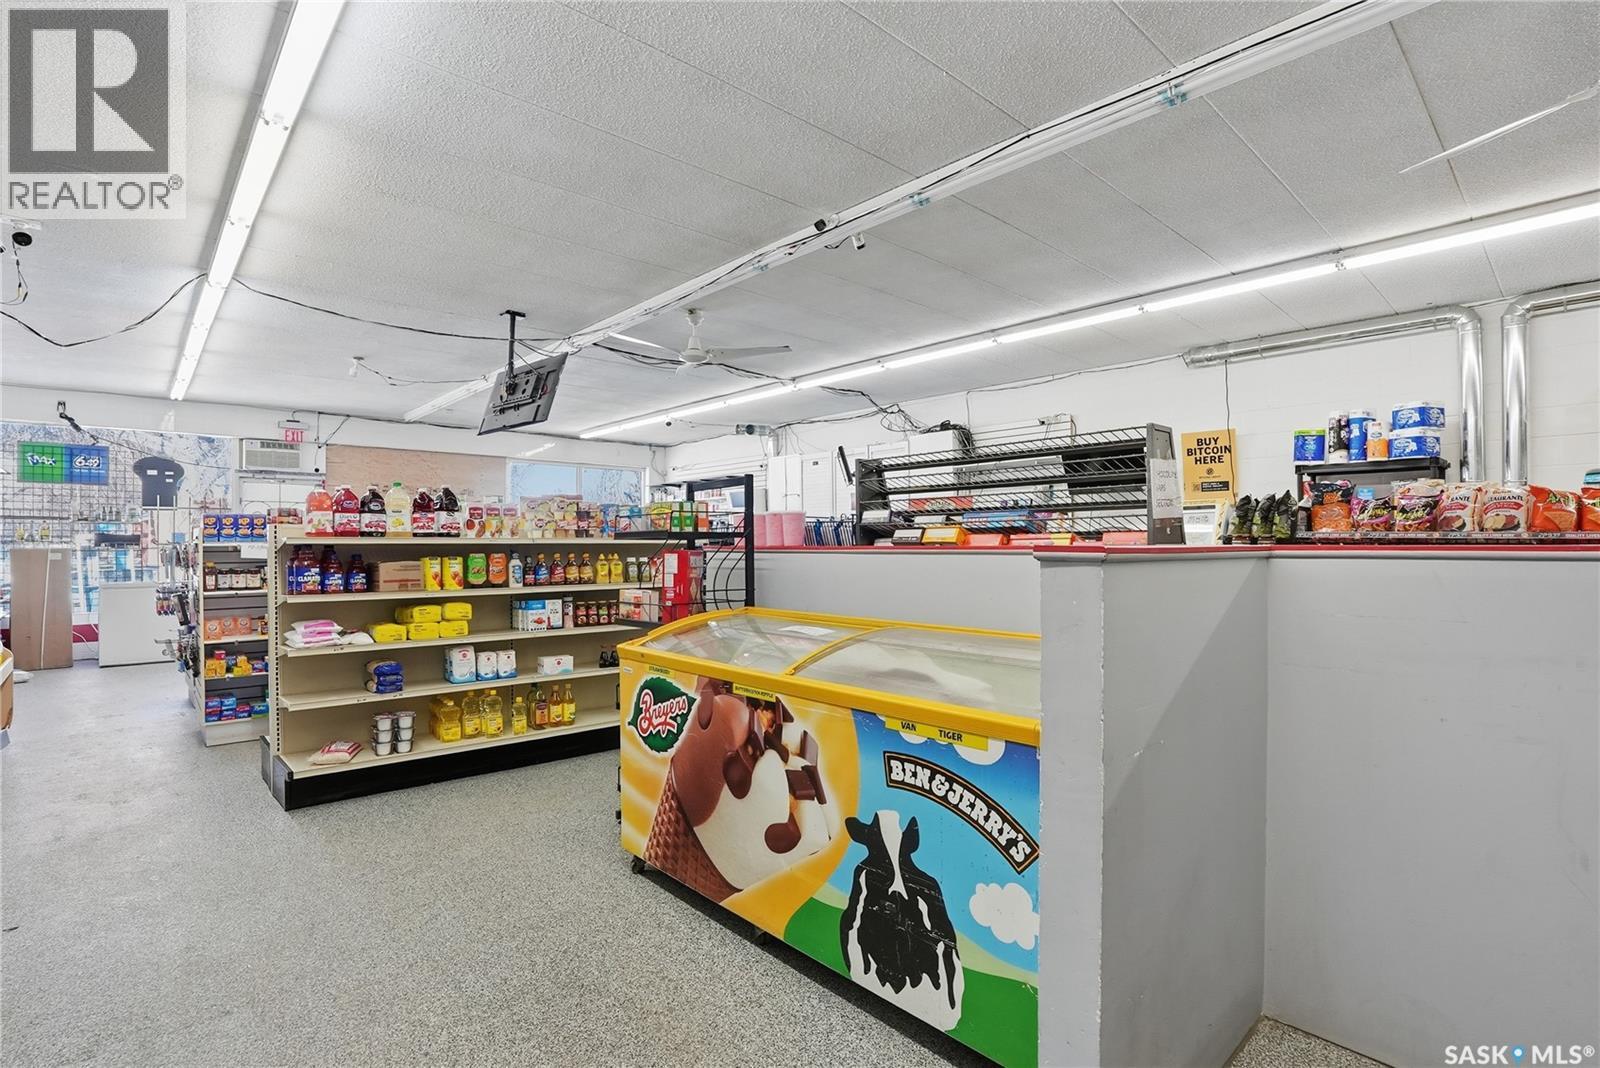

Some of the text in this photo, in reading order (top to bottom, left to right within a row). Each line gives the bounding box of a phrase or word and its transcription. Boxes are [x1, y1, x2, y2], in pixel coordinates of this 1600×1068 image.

[284, 429, 304, 443] EXIT
[1196, 436, 1219, 447] BUY
[1186, 444, 1232, 457] BITCOIN
[1194, 454, 1225, 465] HERE
[637, 688, 688, 738] Breyers
[900, 721, 963, 742] VAN TIGER
[890, 760, 931, 791] BEN
[947, 782, 1032, 863] JERRY'S
